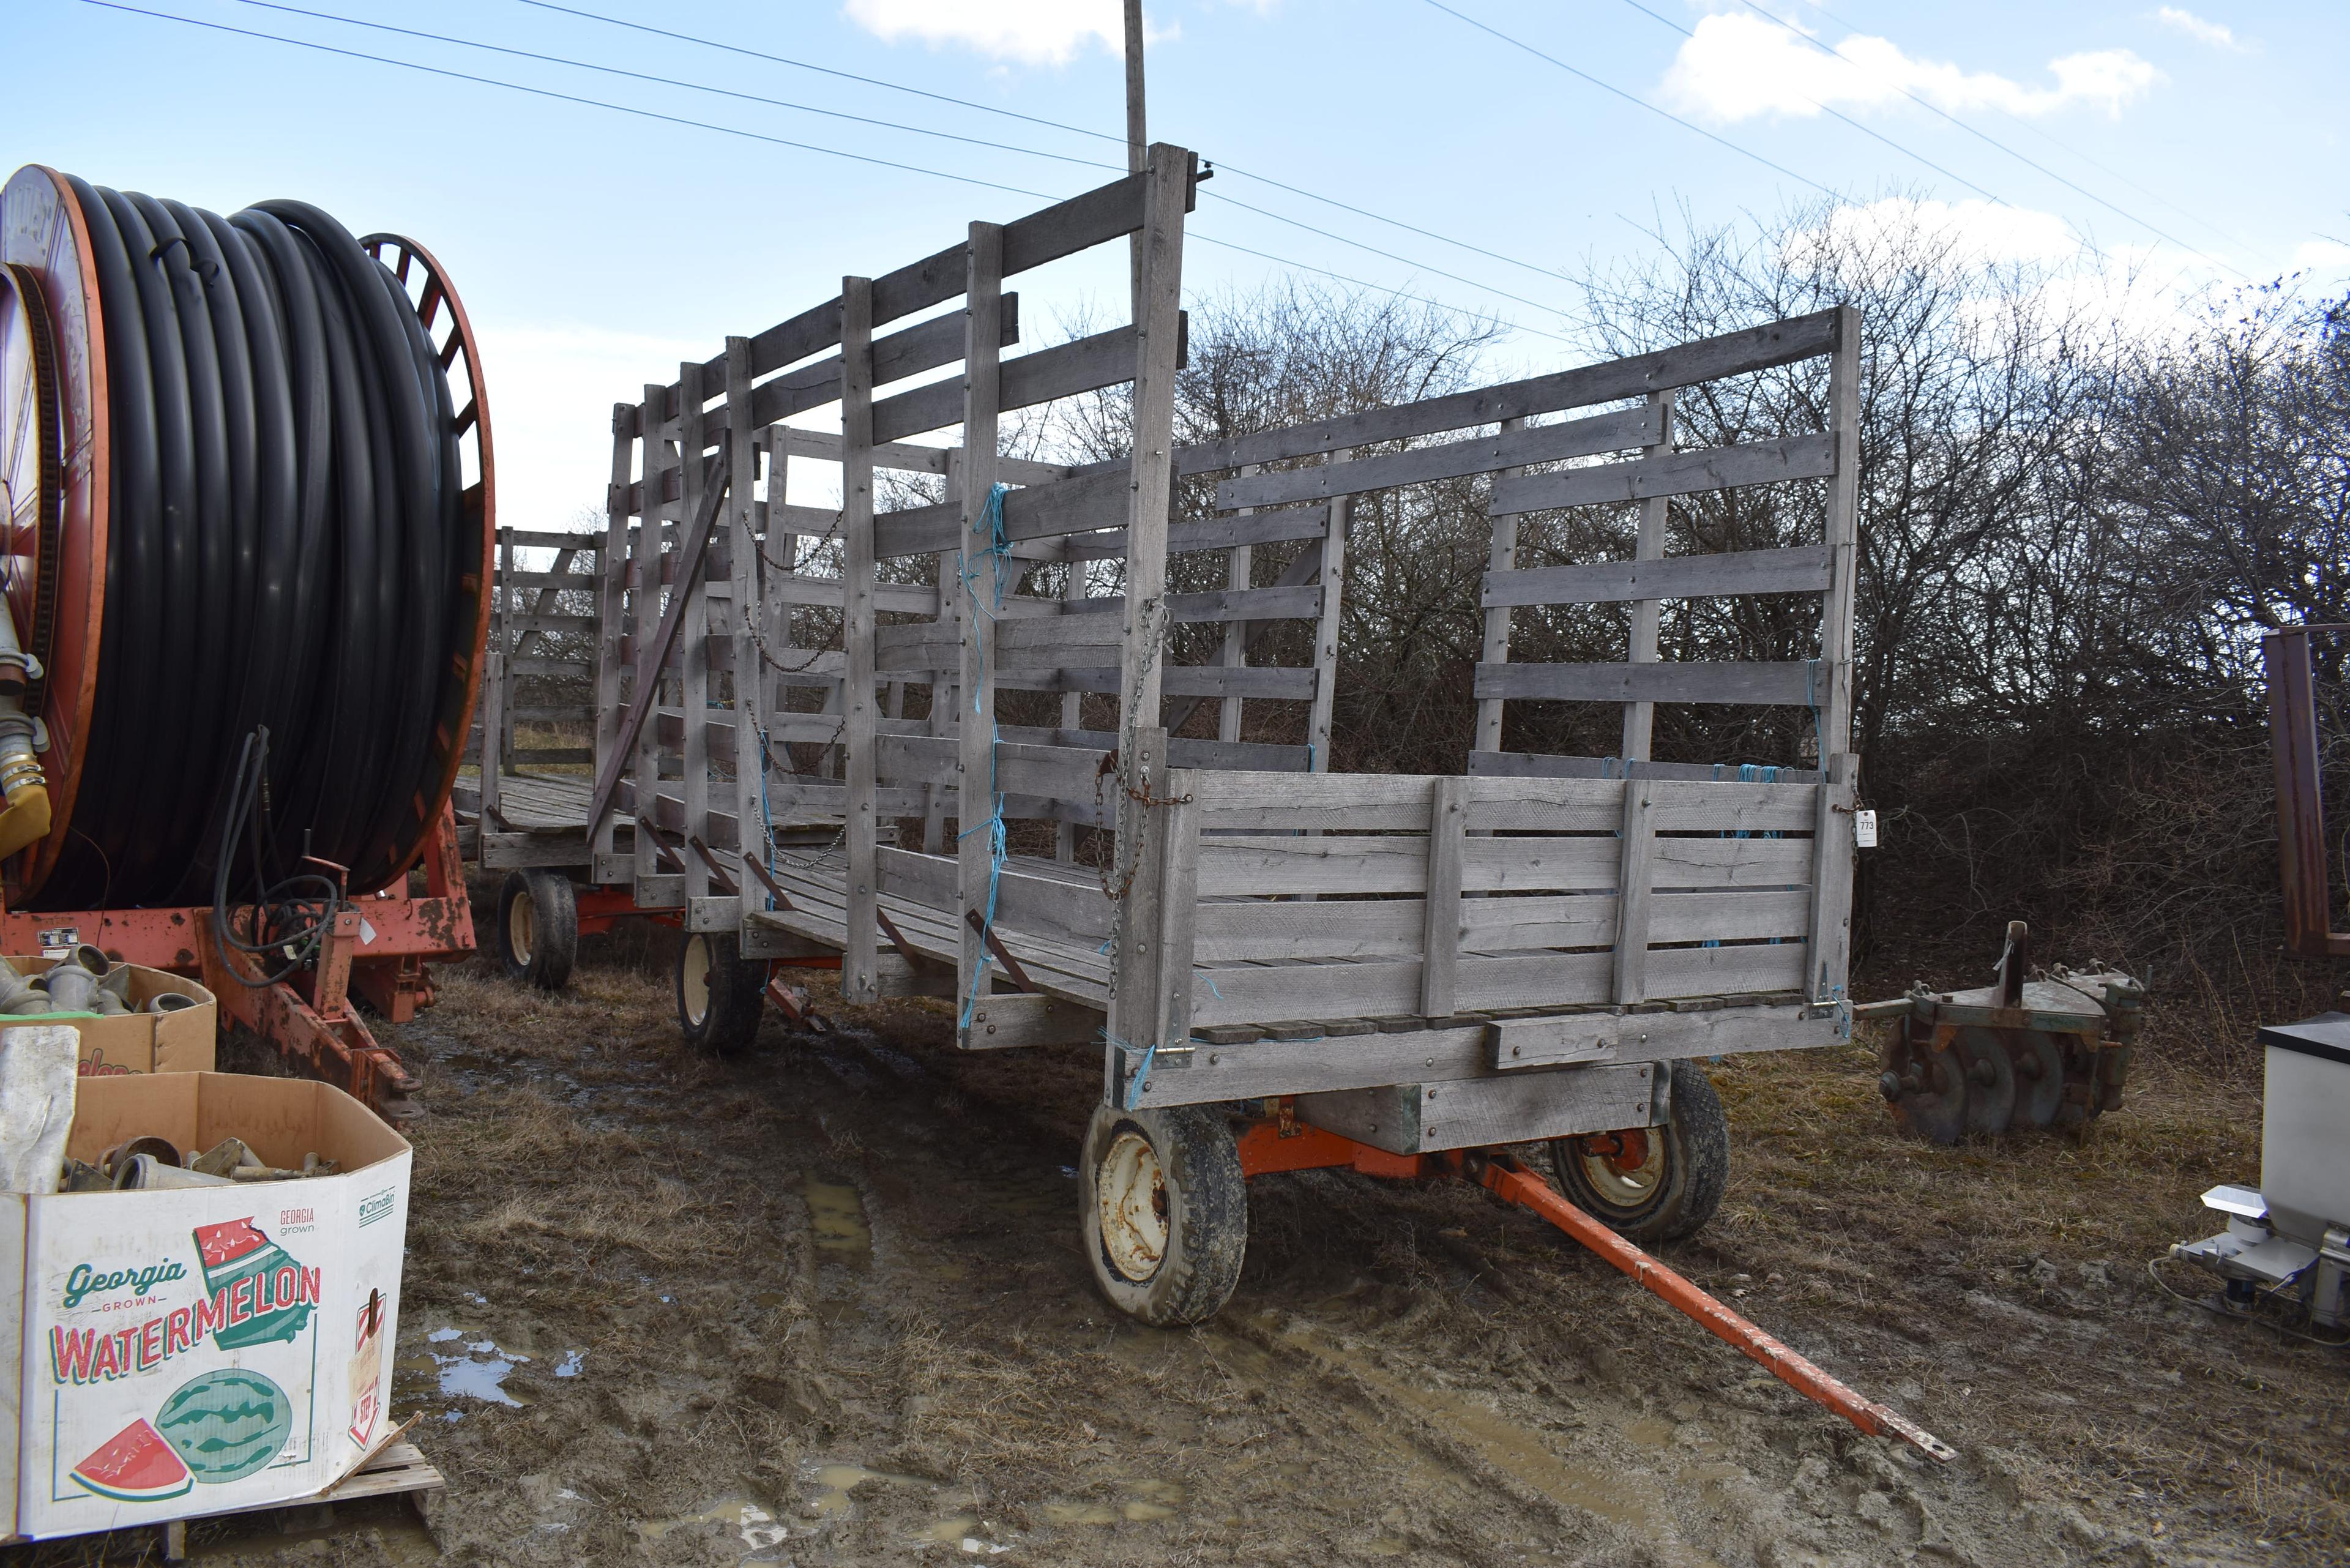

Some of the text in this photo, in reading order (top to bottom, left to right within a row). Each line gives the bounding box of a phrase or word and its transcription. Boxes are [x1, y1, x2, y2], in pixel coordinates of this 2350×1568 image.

[1860, 821, 1874, 830] 773
[367, 1193, 395, 1214] ClimaBin
[280, 1208, 314, 1225] GEORGIA
[280, 1225, 315, 1236] grown
[63, 1257, 187, 1309] Georgia
[102, 1295, 156, 1312] GROWN
[50, 1264, 322, 1383] WATERMELON
[360, 1394, 371, 1424] STEP
